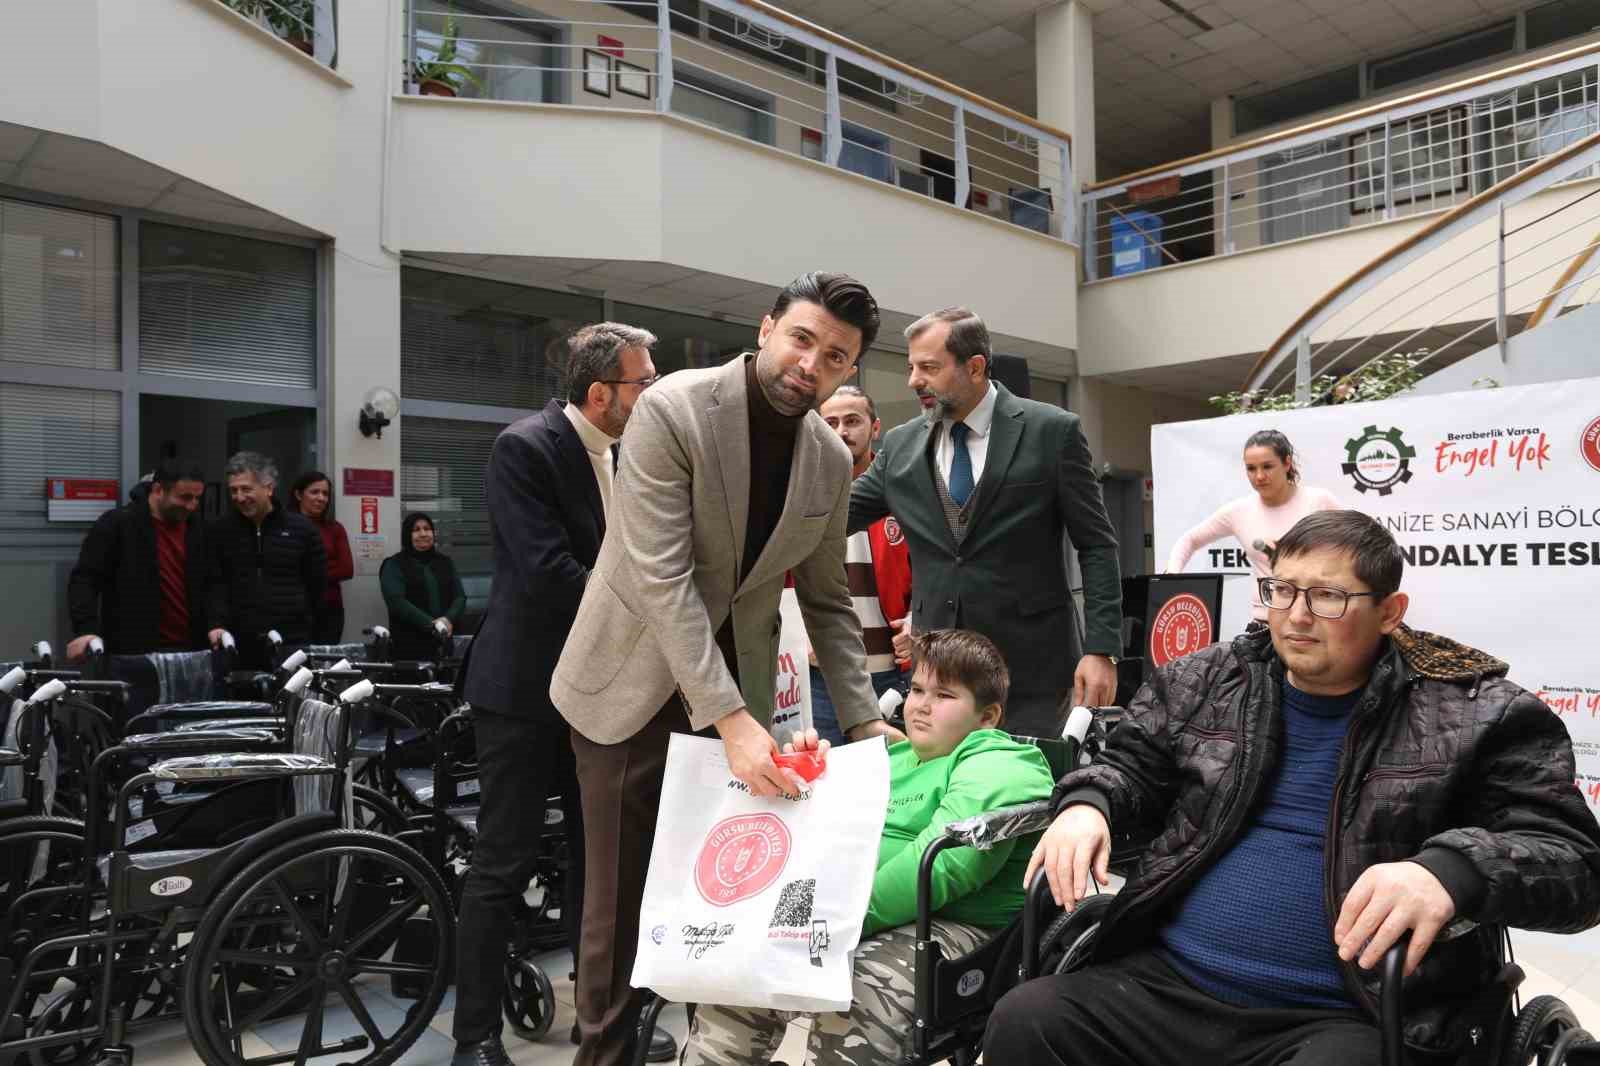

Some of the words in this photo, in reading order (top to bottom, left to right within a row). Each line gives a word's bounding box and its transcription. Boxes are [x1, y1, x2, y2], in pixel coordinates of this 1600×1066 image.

[1447, 429, 1504, 441] Beraberlik
[1506, 426, 1540, 437] Varsa
[1435, 439, 1499, 477] Engel
[1507, 432, 1551, 472] Yok
[1441, 506, 1528, 532] SANAYİ
